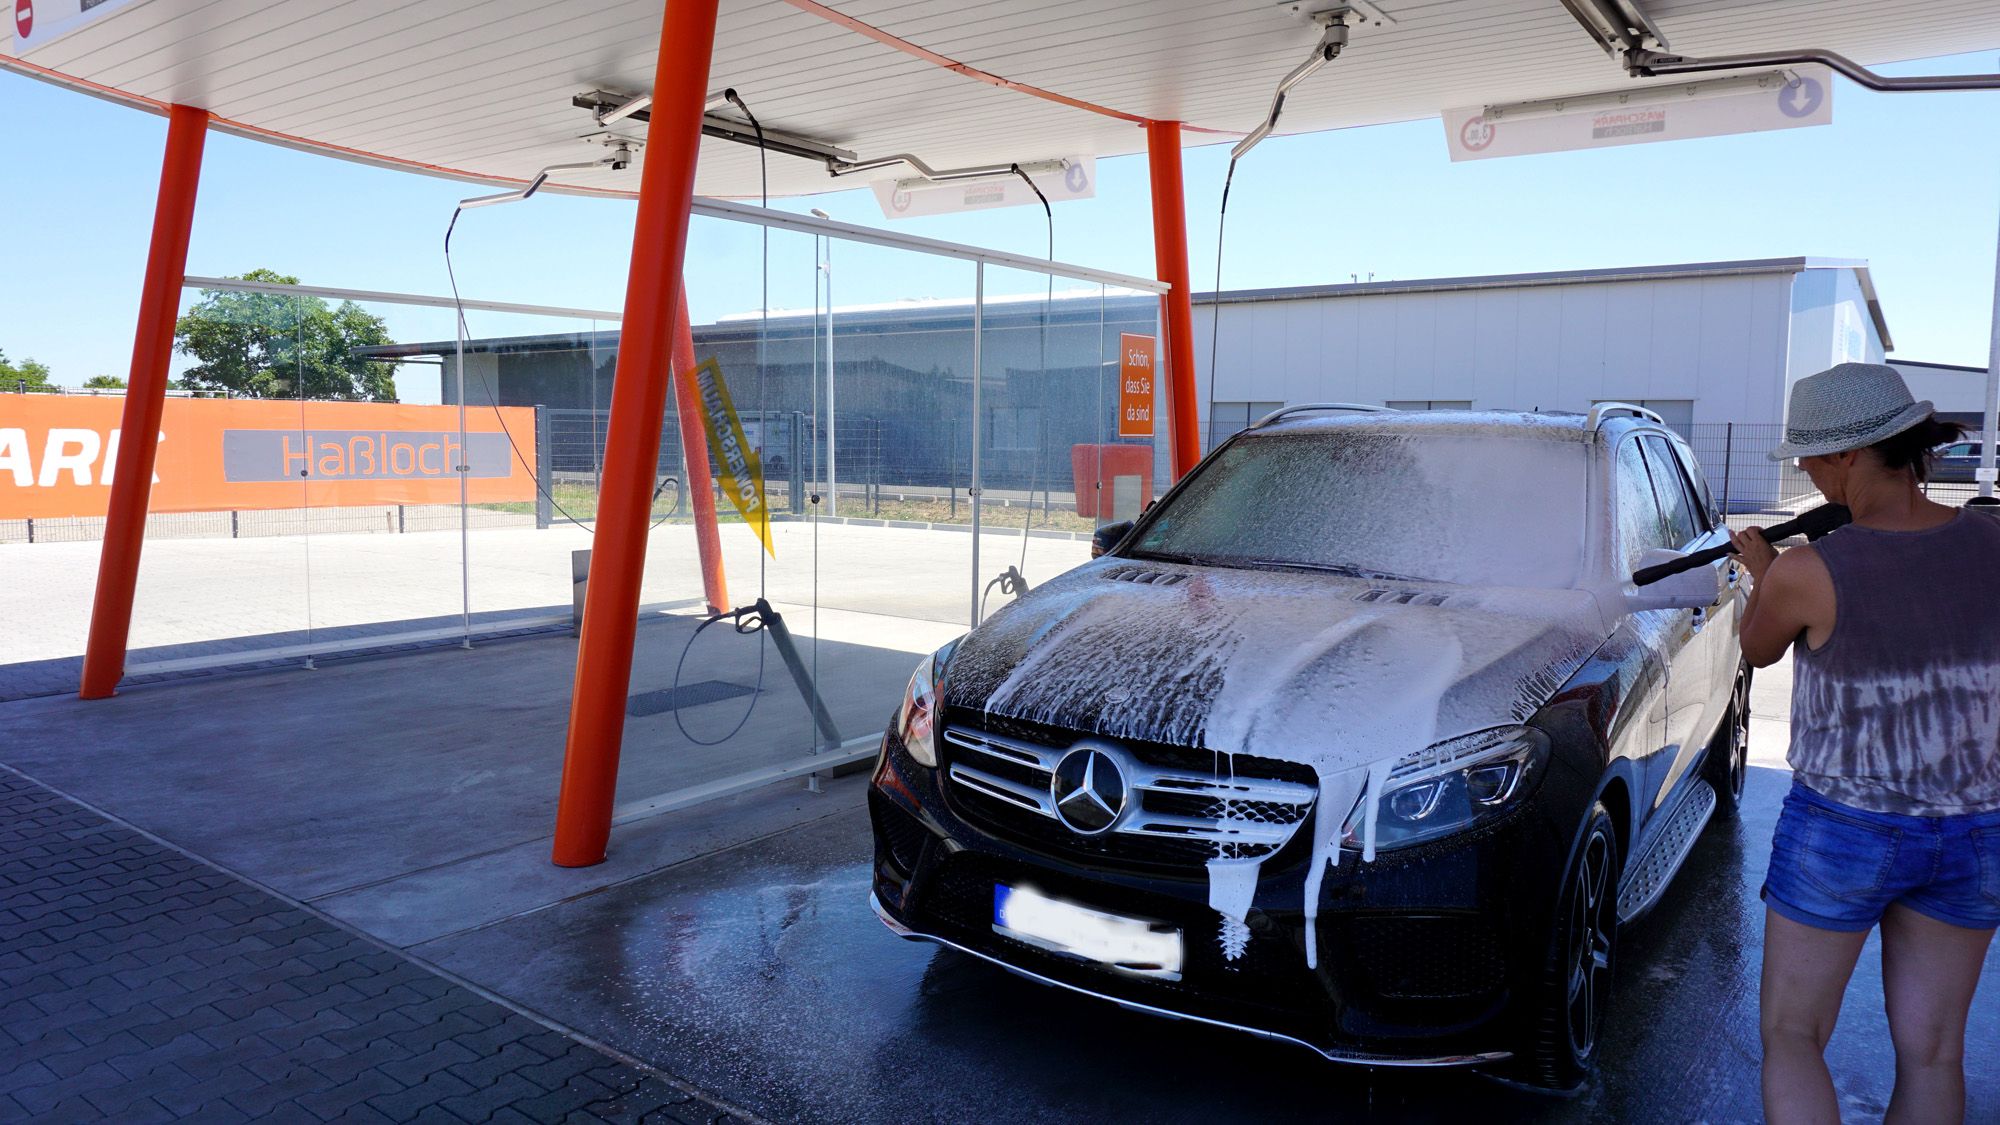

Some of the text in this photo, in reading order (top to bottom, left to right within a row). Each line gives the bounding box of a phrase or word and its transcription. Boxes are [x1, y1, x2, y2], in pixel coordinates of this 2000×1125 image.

[1128, 348, 1150, 369] Schön,
[1125, 376, 1150, 394] dass Sie
[1126, 404, 1150, 421] da sind
[282, 433, 466, 476] Haßloch
